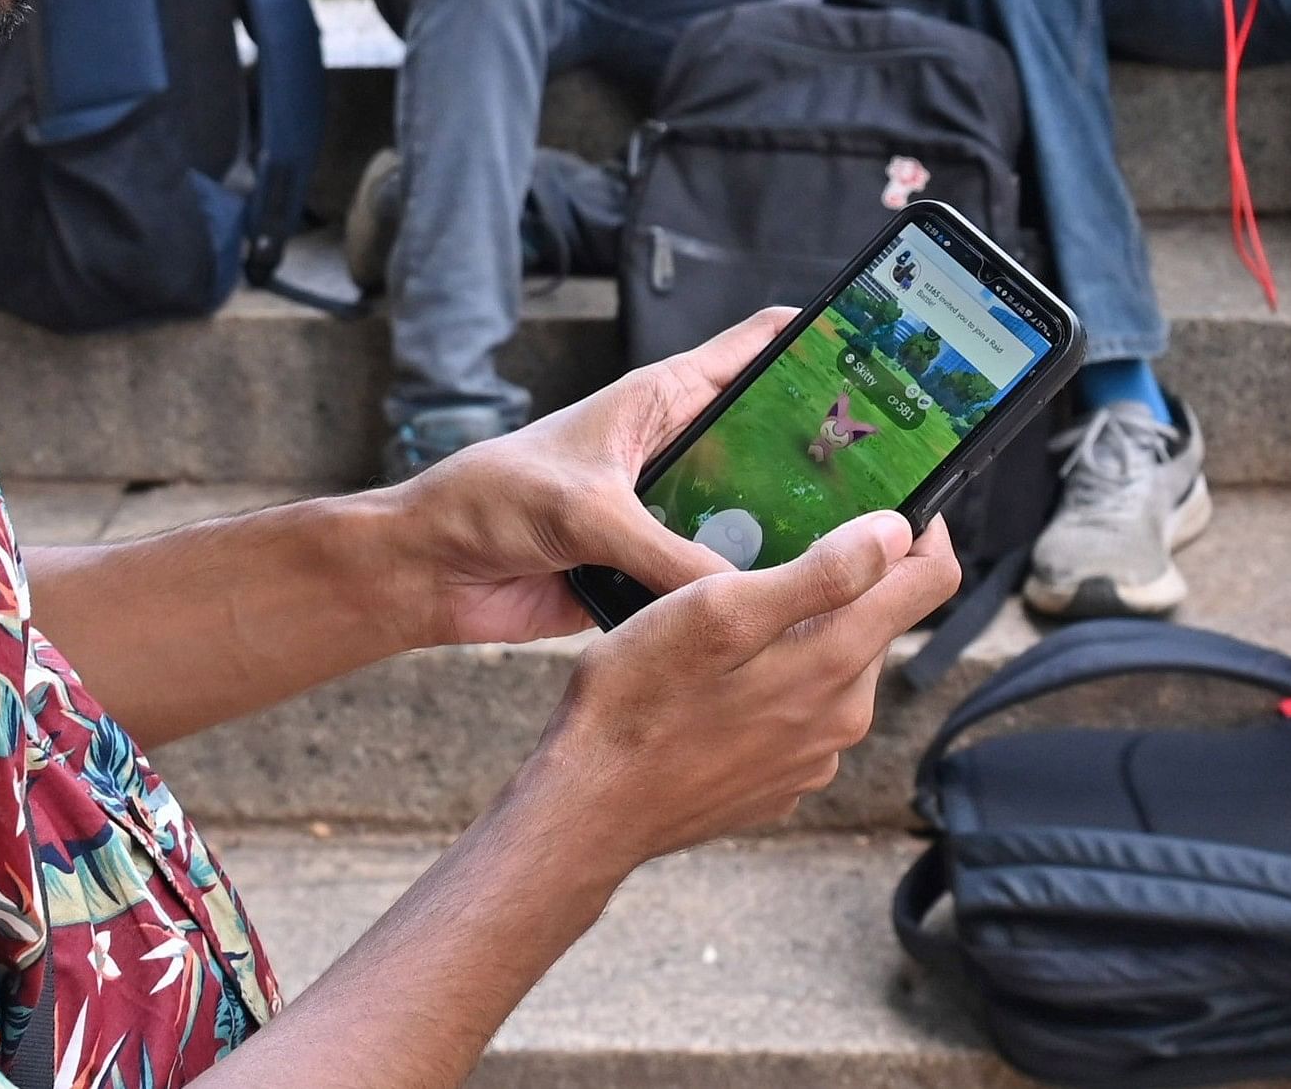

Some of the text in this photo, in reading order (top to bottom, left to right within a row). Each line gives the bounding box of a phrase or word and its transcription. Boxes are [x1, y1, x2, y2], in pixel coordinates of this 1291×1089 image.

[939, 293, 959, 314] invited
[956, 310, 969, 325] you
[967, 320, 975, 330] to
[972, 325, 986, 341] join
[989, 338, 1005, 354] Raid
[852, 361, 877, 387] Skitty
